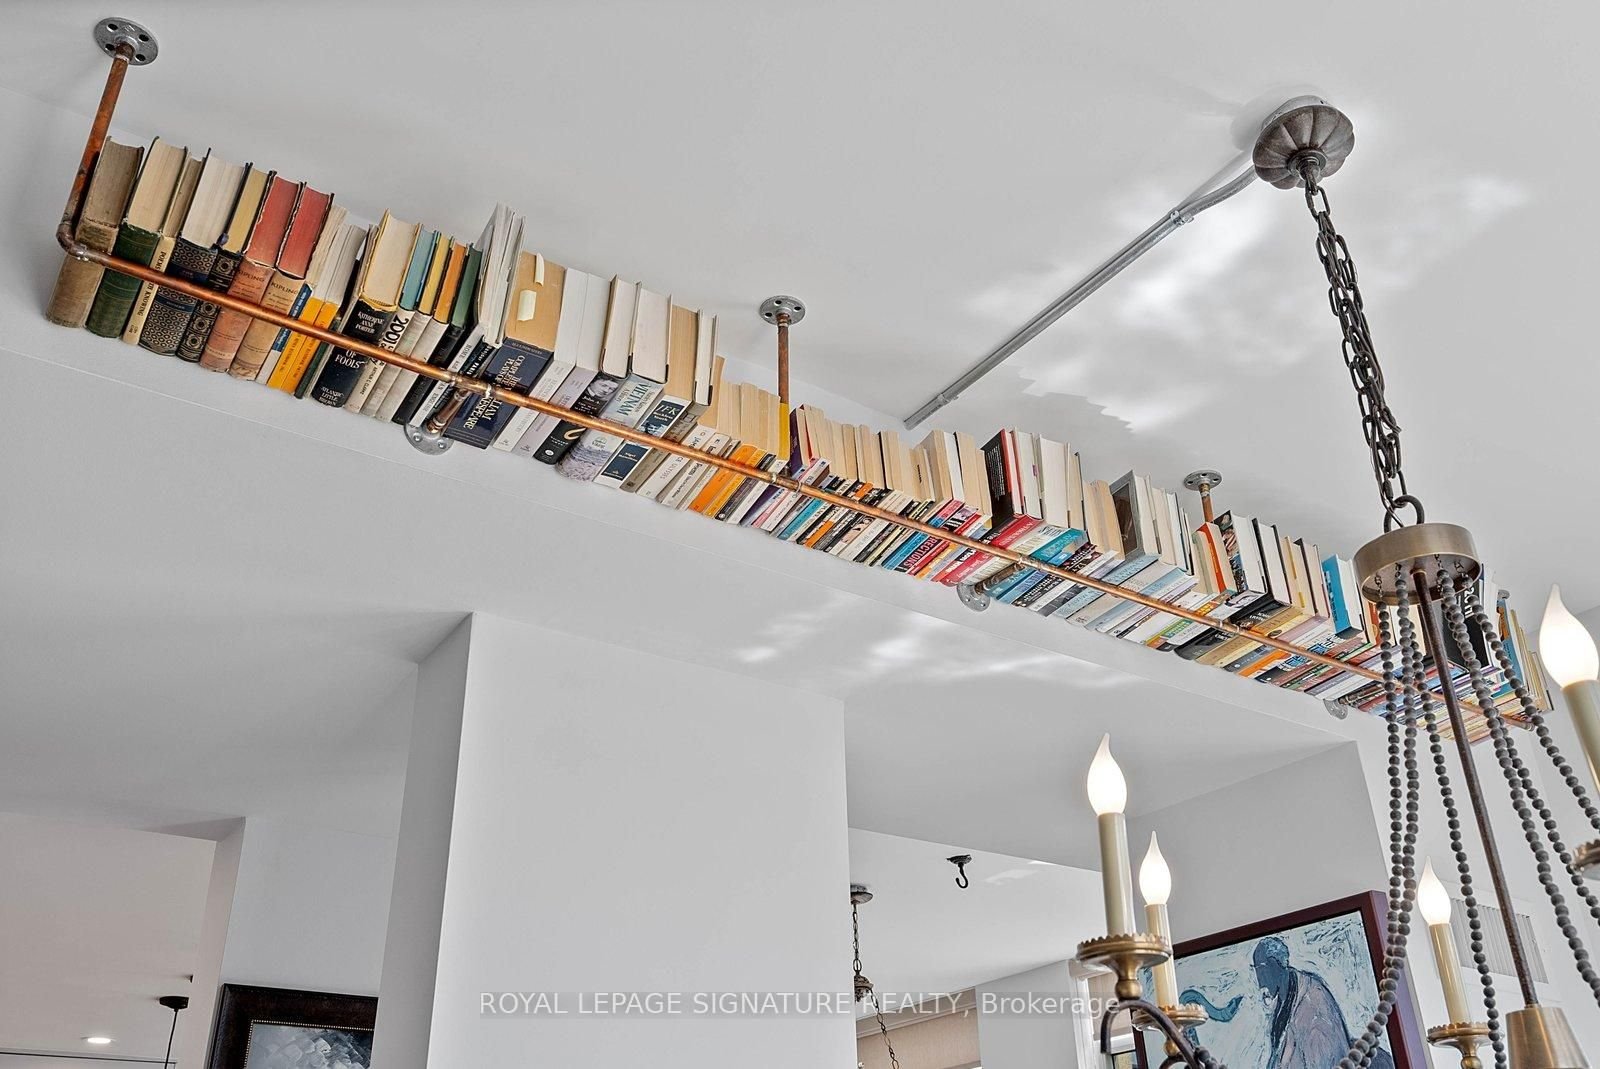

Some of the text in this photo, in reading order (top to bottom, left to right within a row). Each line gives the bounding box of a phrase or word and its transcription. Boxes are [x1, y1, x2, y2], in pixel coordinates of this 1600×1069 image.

[155, 251, 167, 270] POEMS
[270, 281, 297, 294] KIPLING
[137, 290, 151, 316] KNOWING
[335, 354, 361, 369] FOOLS
[500, 354, 526, 385] COMPLETE
[616, 382, 651, 417] VIETNAM
